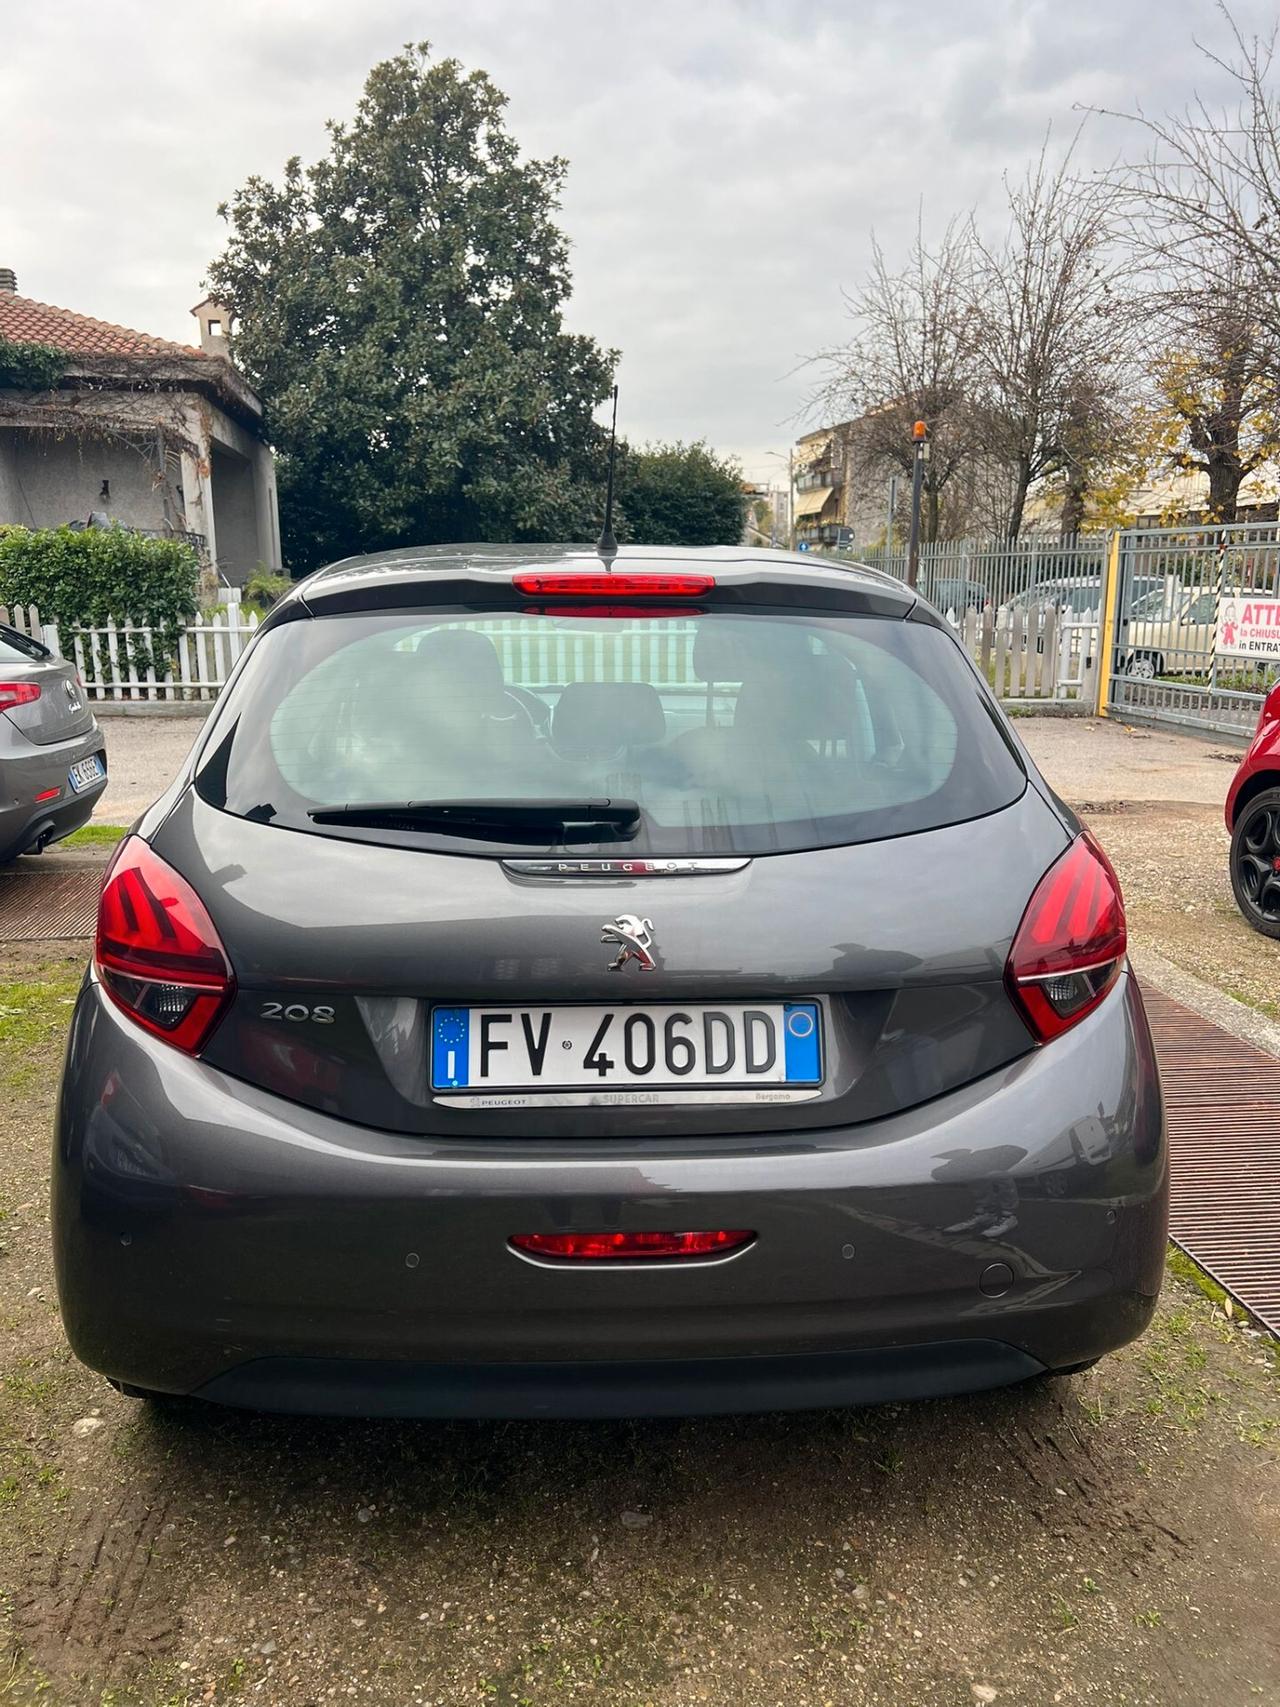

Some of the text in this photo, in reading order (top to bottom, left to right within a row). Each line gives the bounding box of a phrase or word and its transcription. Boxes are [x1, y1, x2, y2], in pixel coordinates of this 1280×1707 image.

[1239, 640, 1280, 652] in ENTRA
[558, 862, 698, 872] PEUGEOT
[260, 1002, 336, 1024] 208
[480, 1012, 552, 1077] FV
[582, 1010, 776, 1077] 406DD
[602, 1094, 659, 1104] SUPERCAR
[755, 1093, 791, 1101] Bergamo
